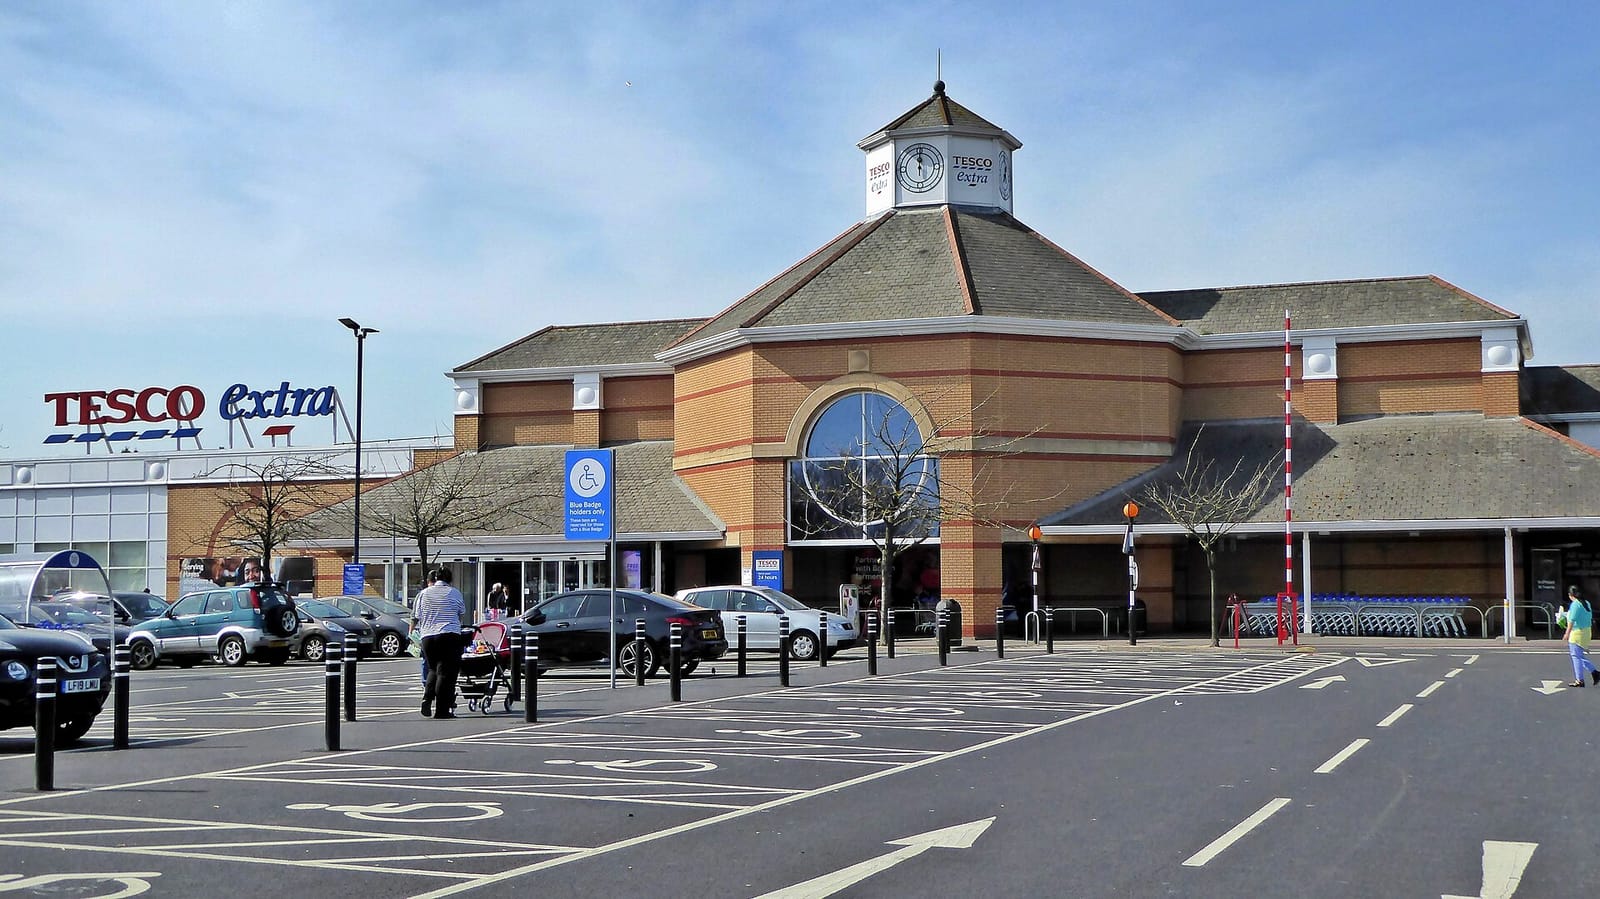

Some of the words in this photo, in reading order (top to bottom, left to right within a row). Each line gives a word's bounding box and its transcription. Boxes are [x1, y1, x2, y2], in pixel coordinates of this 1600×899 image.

[953, 156, 992, 167] TESCO
[869, 161, 890, 176] TESCO
[957, 171, 988, 183] extra
[871, 178, 888, 192] extra
[44, 385, 206, 427] TESCO
[218, 381, 336, 421] extra
[583, 501, 602, 509] Badge
